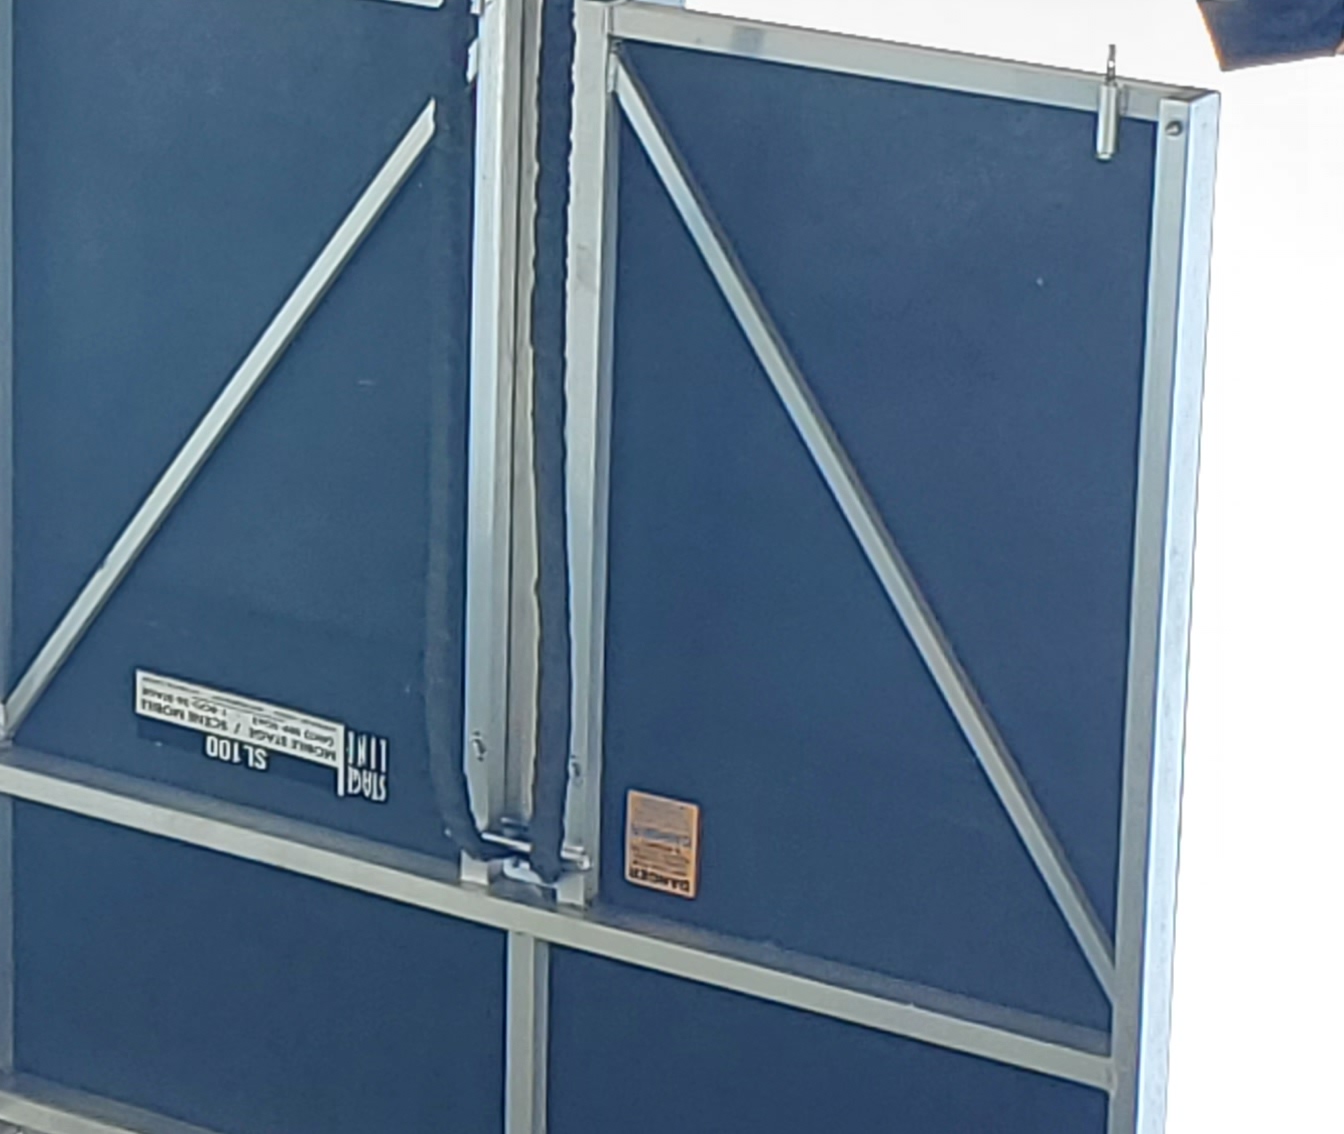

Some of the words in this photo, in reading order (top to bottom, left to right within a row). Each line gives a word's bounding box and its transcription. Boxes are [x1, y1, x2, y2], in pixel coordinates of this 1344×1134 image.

[140, 698, 186, 720] MOBILE
[187, 710, 229, 731] SCENE
[248, 726, 288, 747] STAGE
[205, 735, 269, 770] SL100
[290, 738, 336, 761] MOBILE
[346, 731, 387, 773] LINE
[629, 867, 690, 893] DANGER
